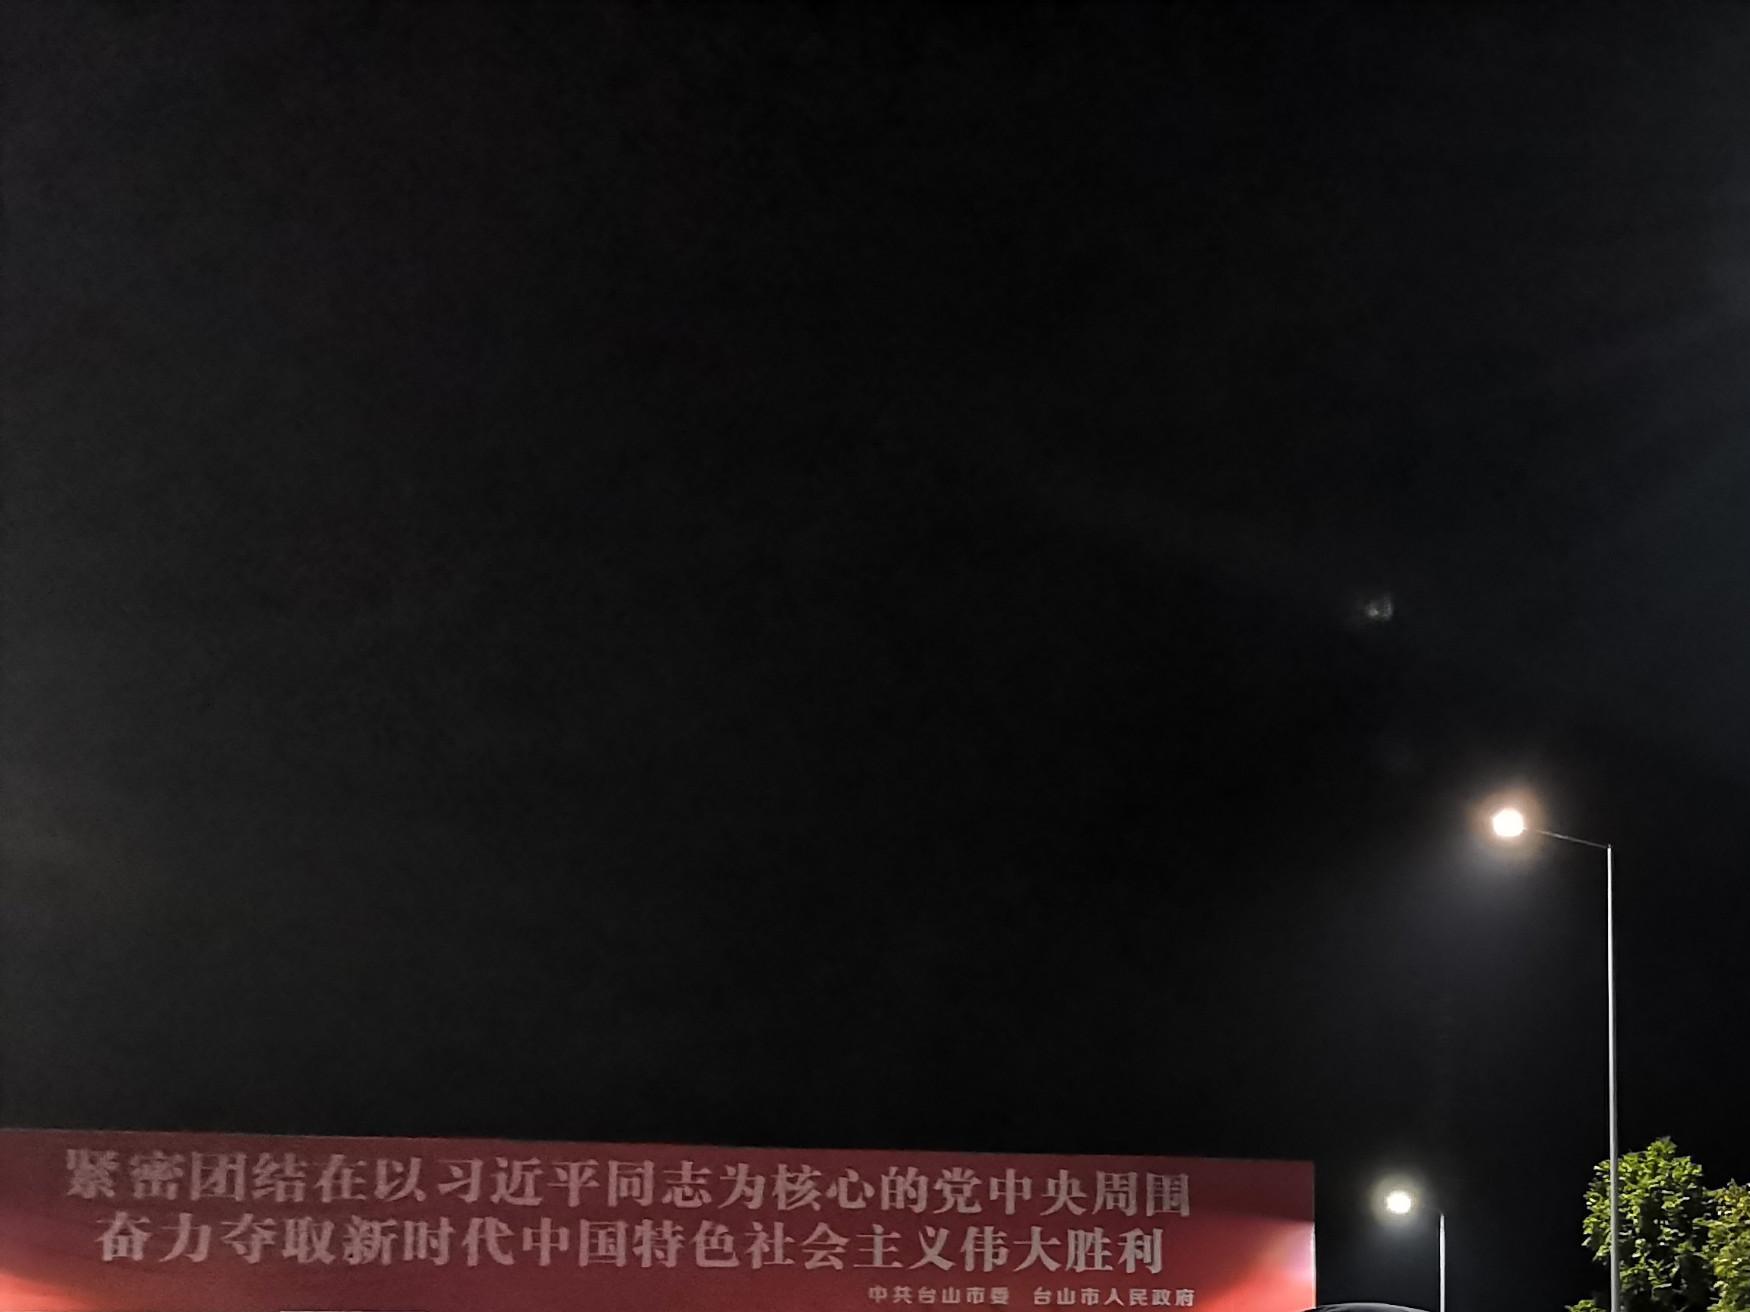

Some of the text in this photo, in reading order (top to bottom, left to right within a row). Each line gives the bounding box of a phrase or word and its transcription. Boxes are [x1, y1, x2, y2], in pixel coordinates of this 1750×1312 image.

[66, 1148, 1190, 1217] 紧密团结在以习近平同志为核心的党中央周围
[96, 1210, 1164, 1275] 奋力夺取新时代中国特色社会主义伟大胜利
[868, 1285, 1195, 1308] 中共台山市委 台山市人民政府
